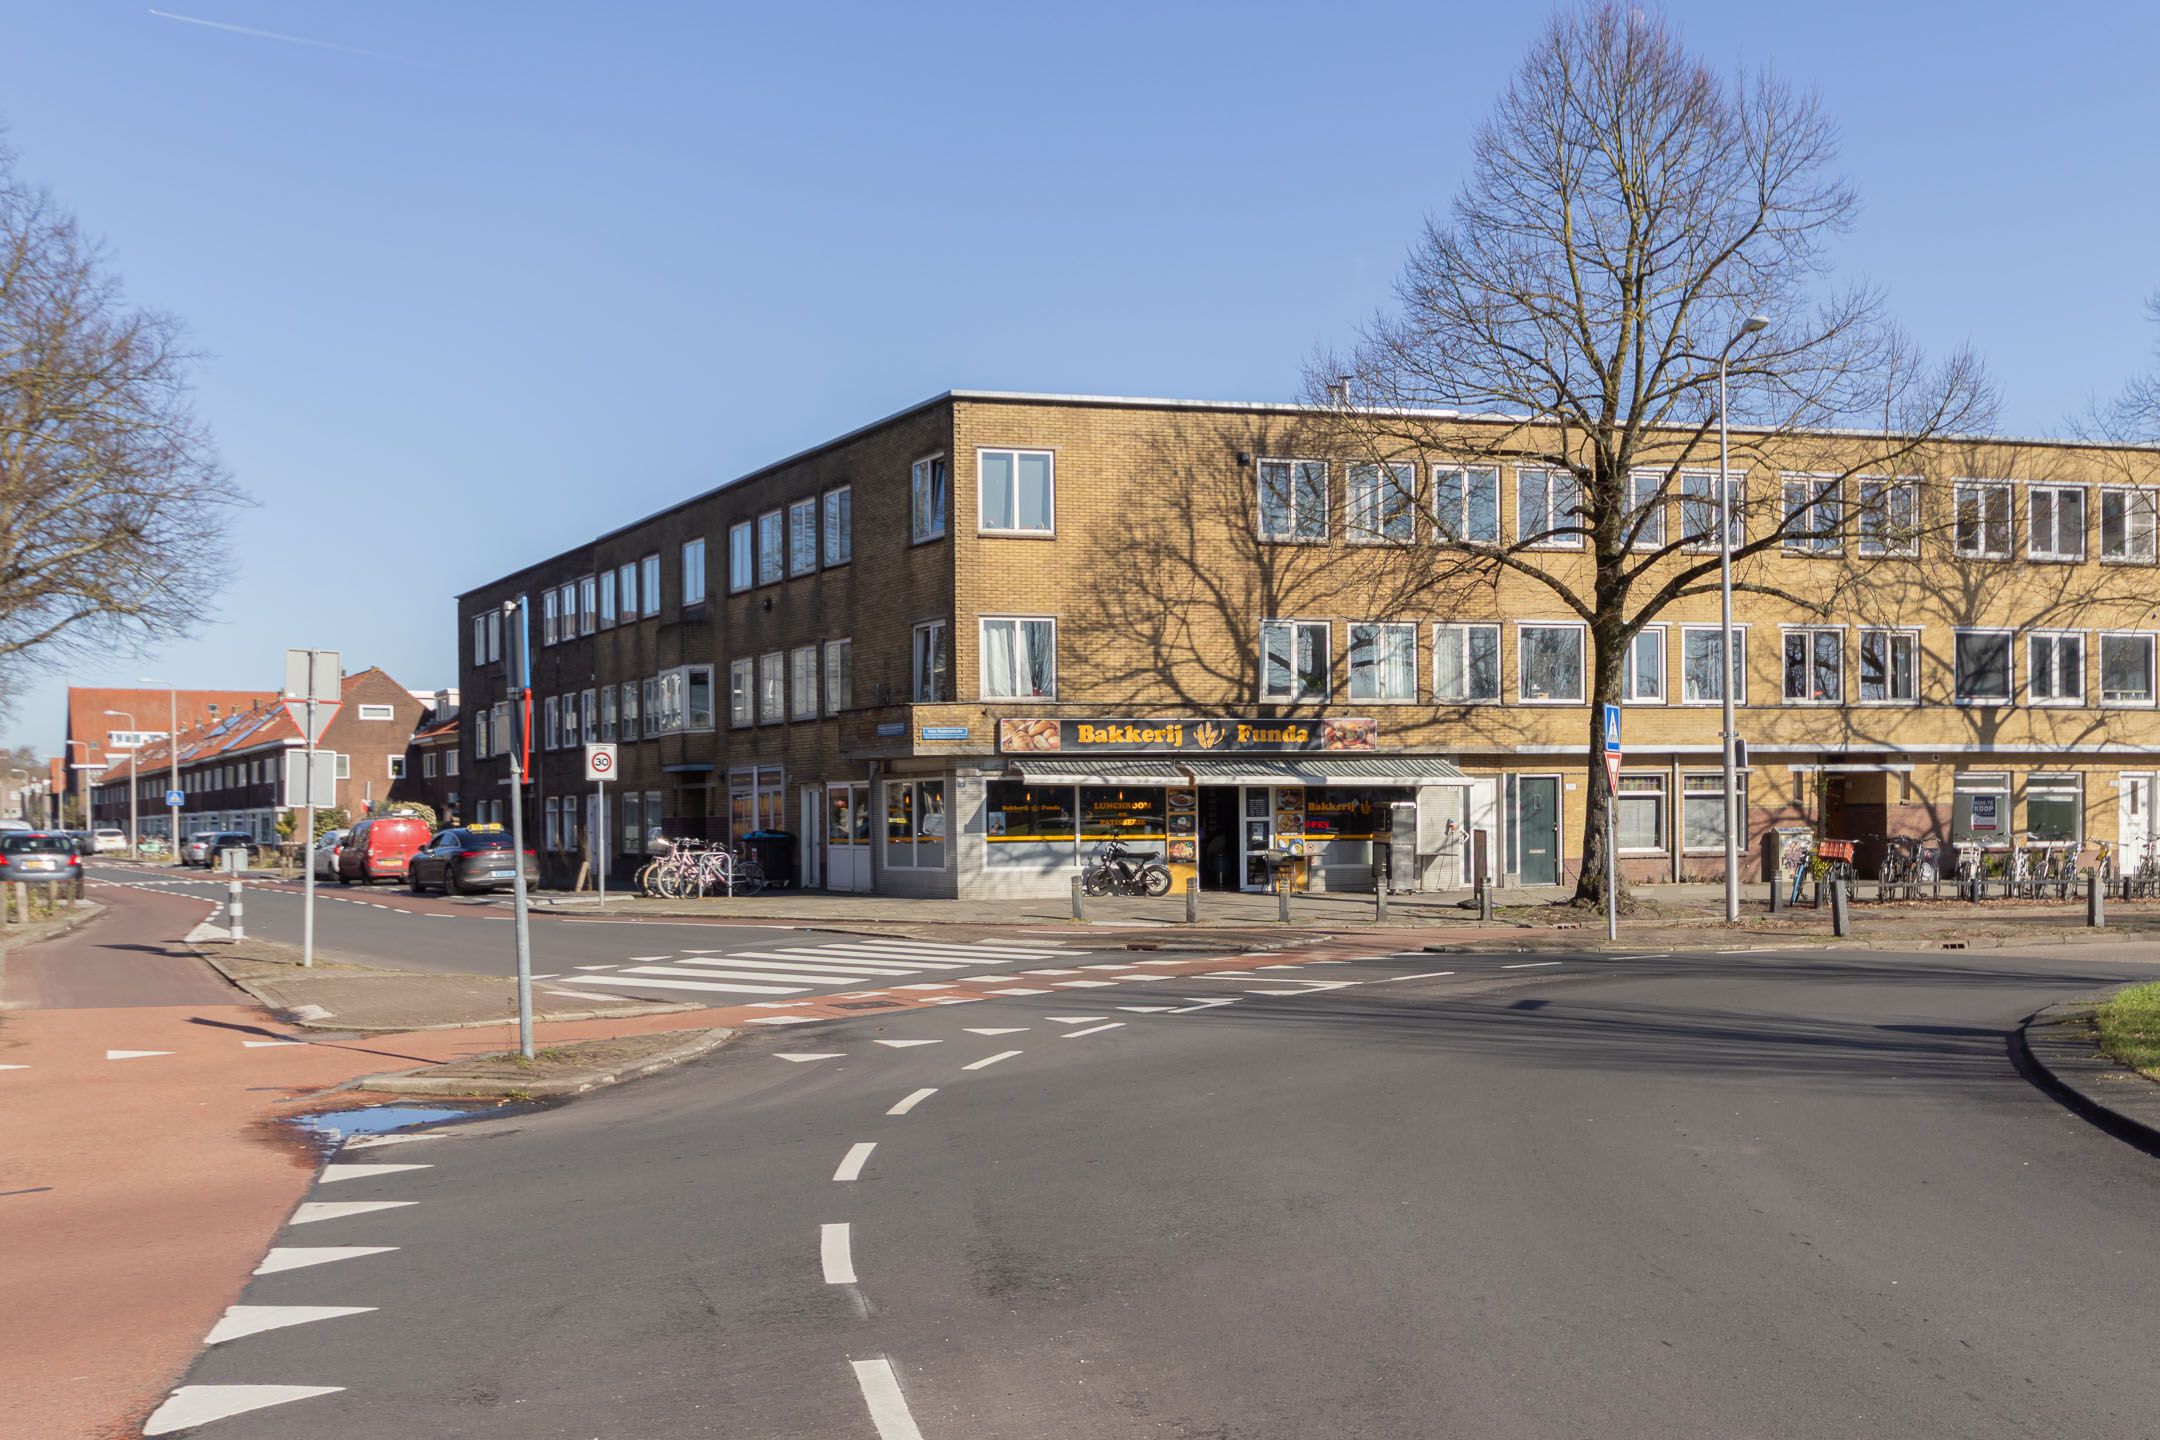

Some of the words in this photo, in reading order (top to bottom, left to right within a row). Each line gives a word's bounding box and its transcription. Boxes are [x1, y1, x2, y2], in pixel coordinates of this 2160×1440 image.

[1077, 724, 1183, 747] Bakkerij
[1236, 725, 1309, 743] Funda
[595, 757, 609, 766] 30
[1094, 802, 1152, 810] LUNCHROOM
[1307, 802, 1355, 812] Bakkerij
[1100, 818, 1147, 826] PATISSERIE
[1304, 820, 1329, 829] OPEN
